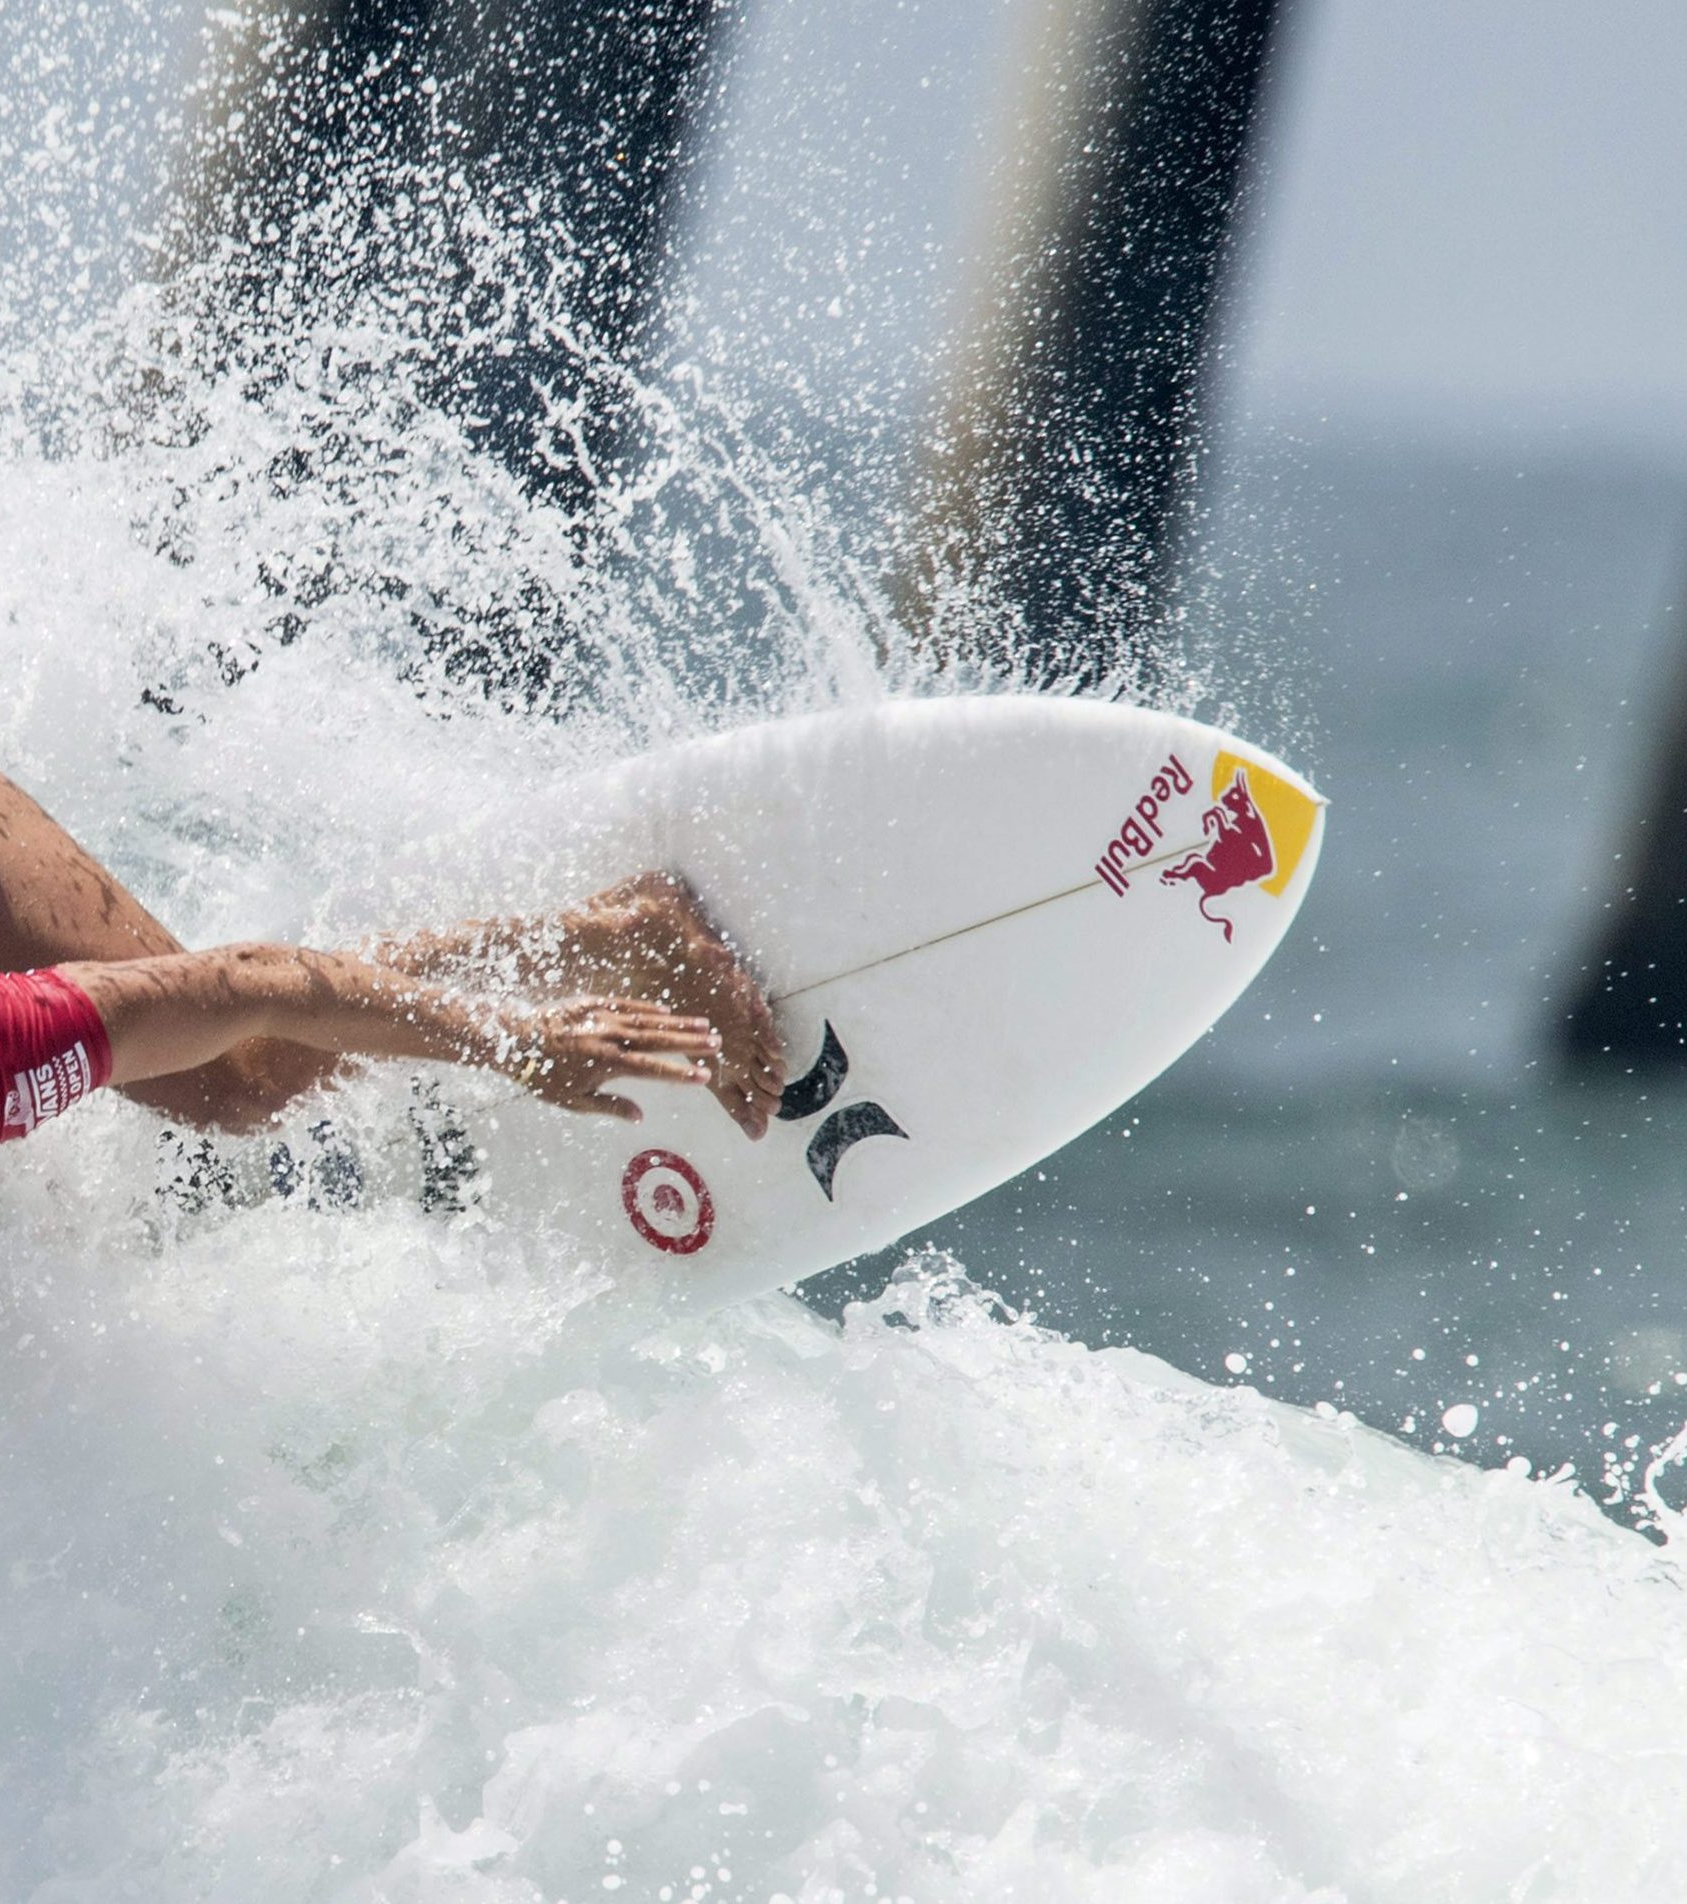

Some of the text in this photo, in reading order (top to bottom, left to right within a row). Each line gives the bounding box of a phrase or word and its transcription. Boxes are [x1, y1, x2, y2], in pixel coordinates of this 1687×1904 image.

[1095, 754, 1193, 898] Red Bull
[29, 1064, 58, 1127] VANS
[62, 1049, 82, 1098] OPEN
